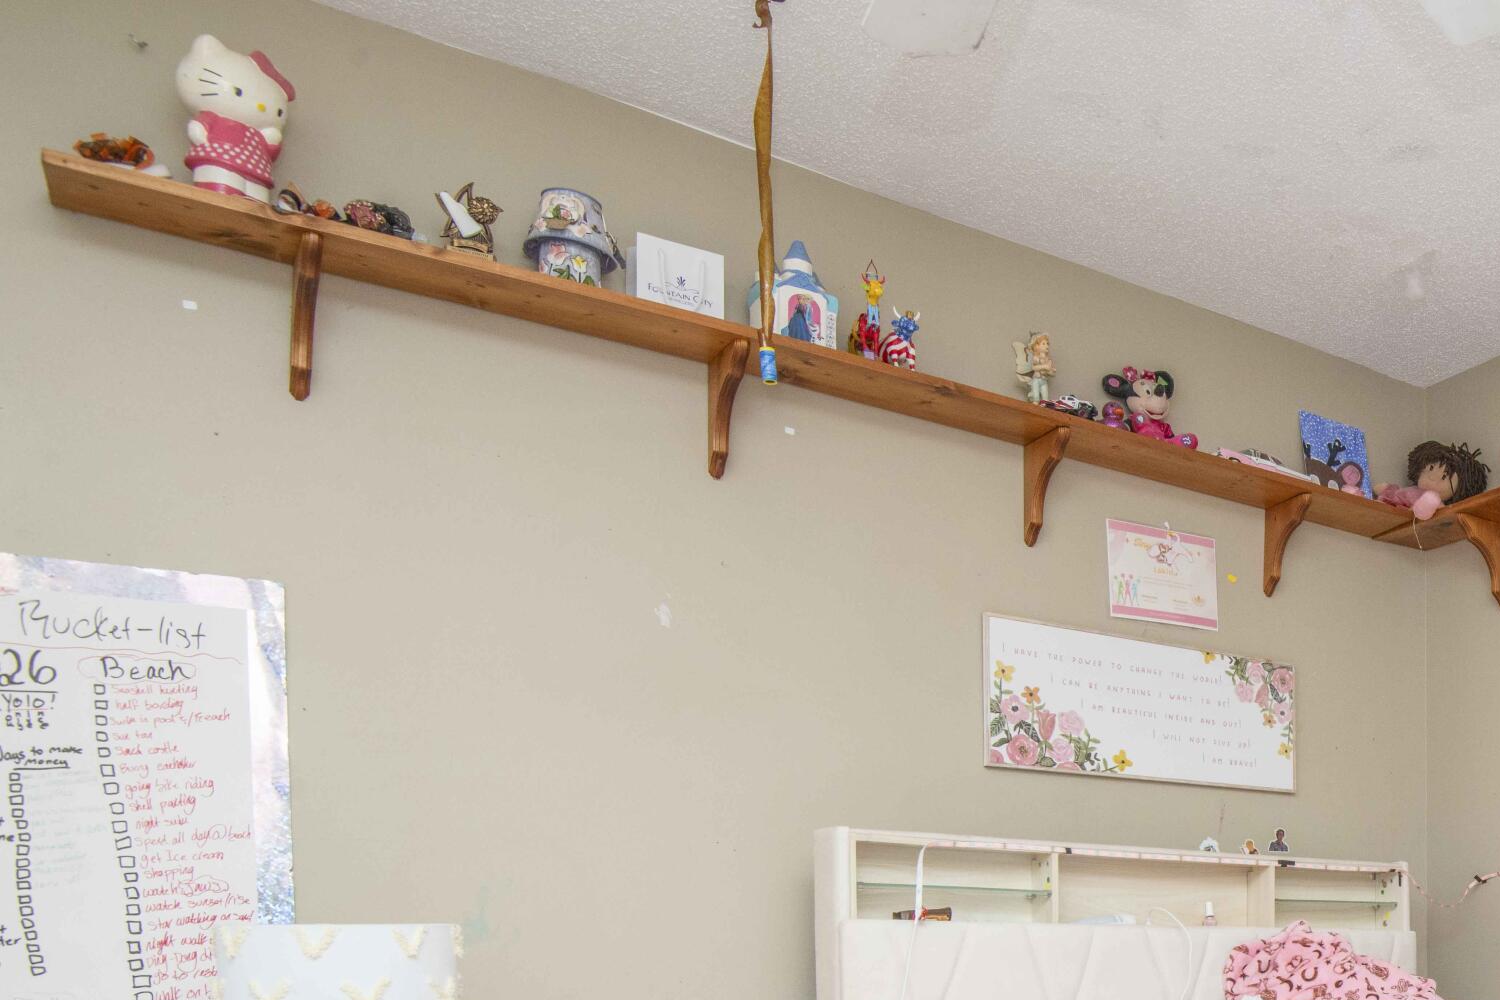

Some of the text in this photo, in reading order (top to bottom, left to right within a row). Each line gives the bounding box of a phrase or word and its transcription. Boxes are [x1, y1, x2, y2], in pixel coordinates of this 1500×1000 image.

[100, 656, 191, 681] Beach
[1014, 648, 1038, 658] HAVE
[1048, 653, 1063, 662] THE
[1072, 656, 1102, 667] POWER
[1111, 662, 1122, 670] TO
[1130, 666, 1162, 676] CHANGE
[1171, 672, 1185, 680] THE
[1062, 679, 1080, 688] CAN
[1088, 682, 1098, 690] BE
[1106, 685, 1151, 697] ANYTHING
[1169, 694, 1193, 702] WANT
[1092, 704, 1104, 712] AM
[1112, 706, 1157, 719] BEAUTIFUL
[1200, 718, 1216, 726] AND
[1163, 733, 1181, 742] WILL
[1189, 736, 1206, 744] NOT
[0, 745, 83, 764] ays to make
[1212, 757, 1223, 765] AM
